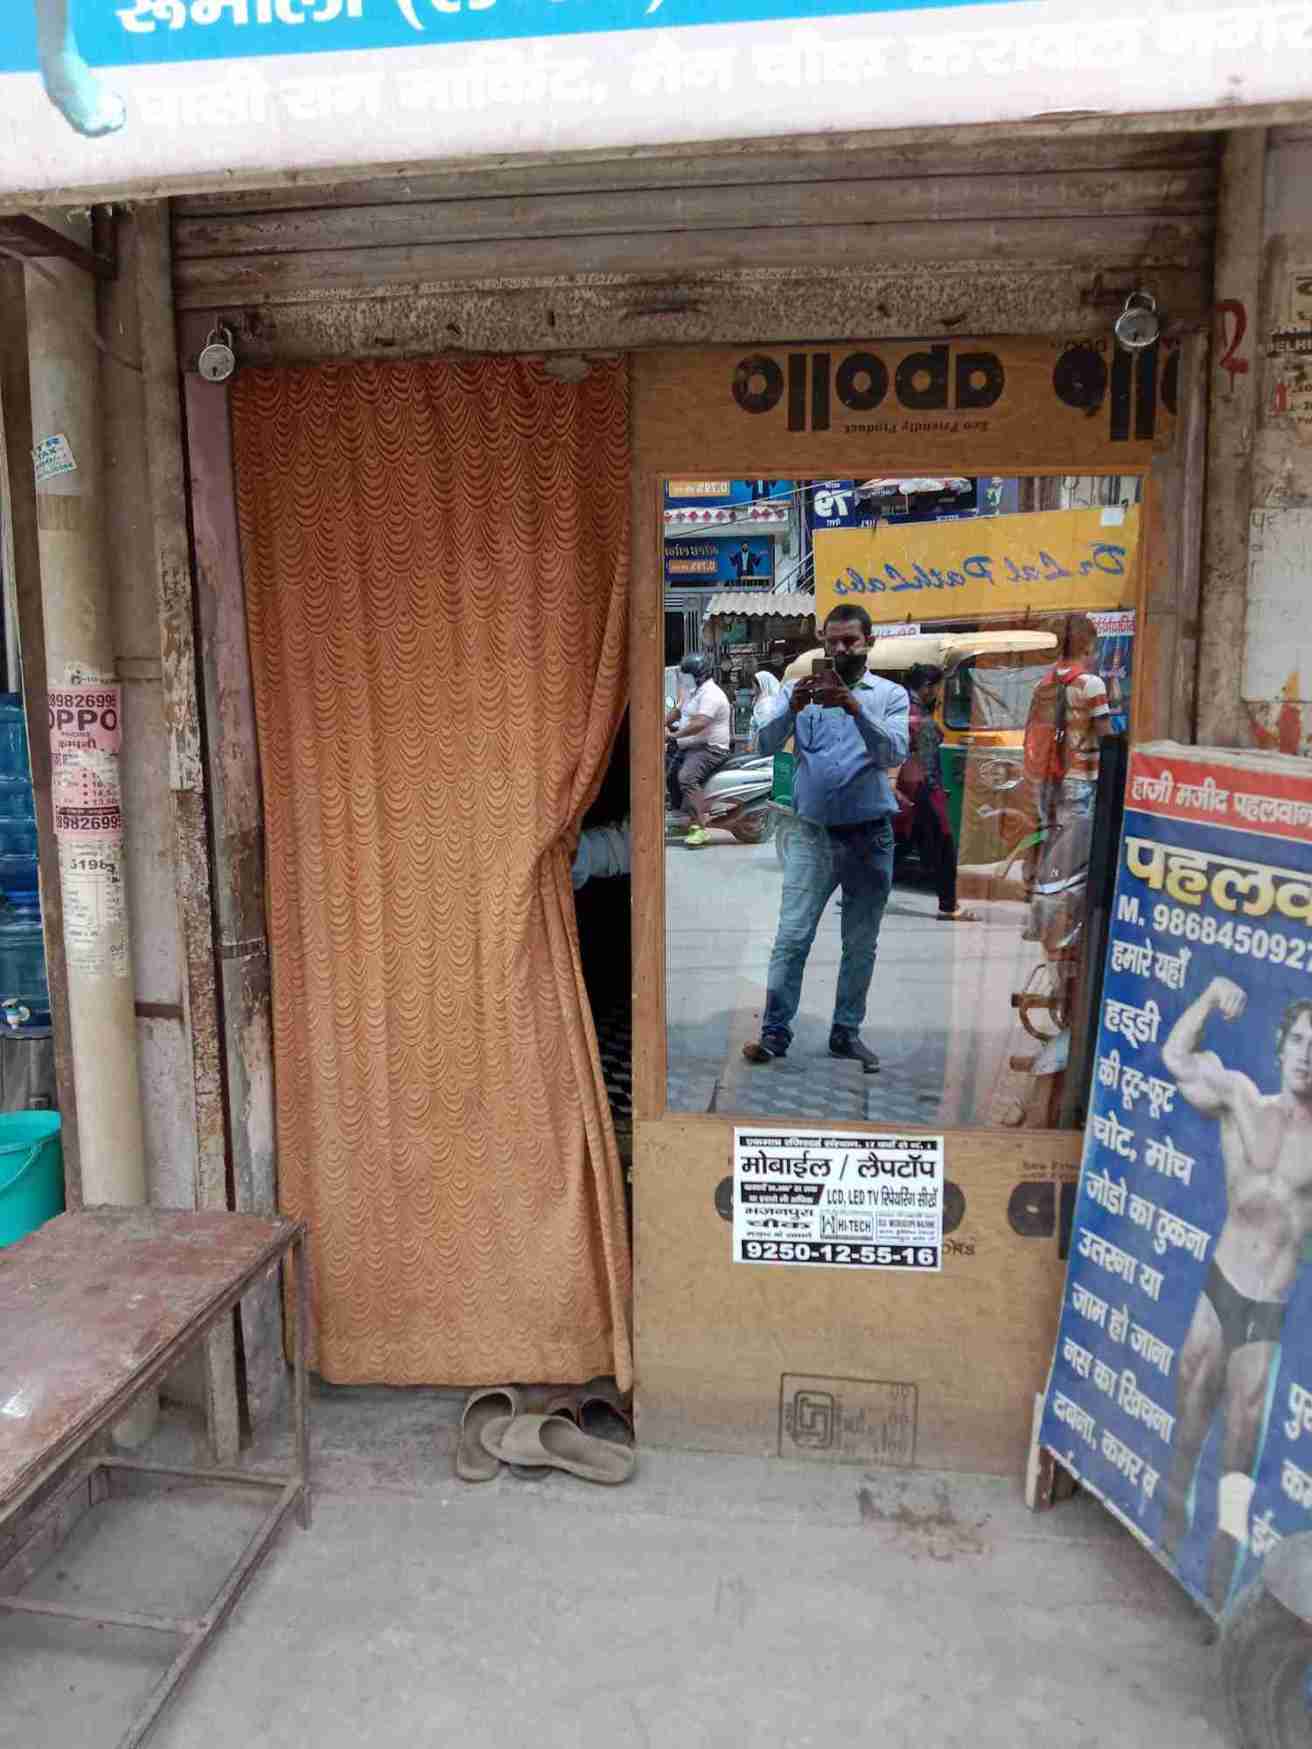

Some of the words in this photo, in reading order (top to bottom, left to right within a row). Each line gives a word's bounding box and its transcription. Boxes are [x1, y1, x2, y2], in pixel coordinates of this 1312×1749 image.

[732, 344, 1004, 431] apollo
[1117, 895, 1145, 927] M.
[740, 1150, 832, 1178] मोबाईल
[857, 1151, 935, 1178] लैपटॉप
[745, 1241, 935, 1266] 9250-12-55-16
